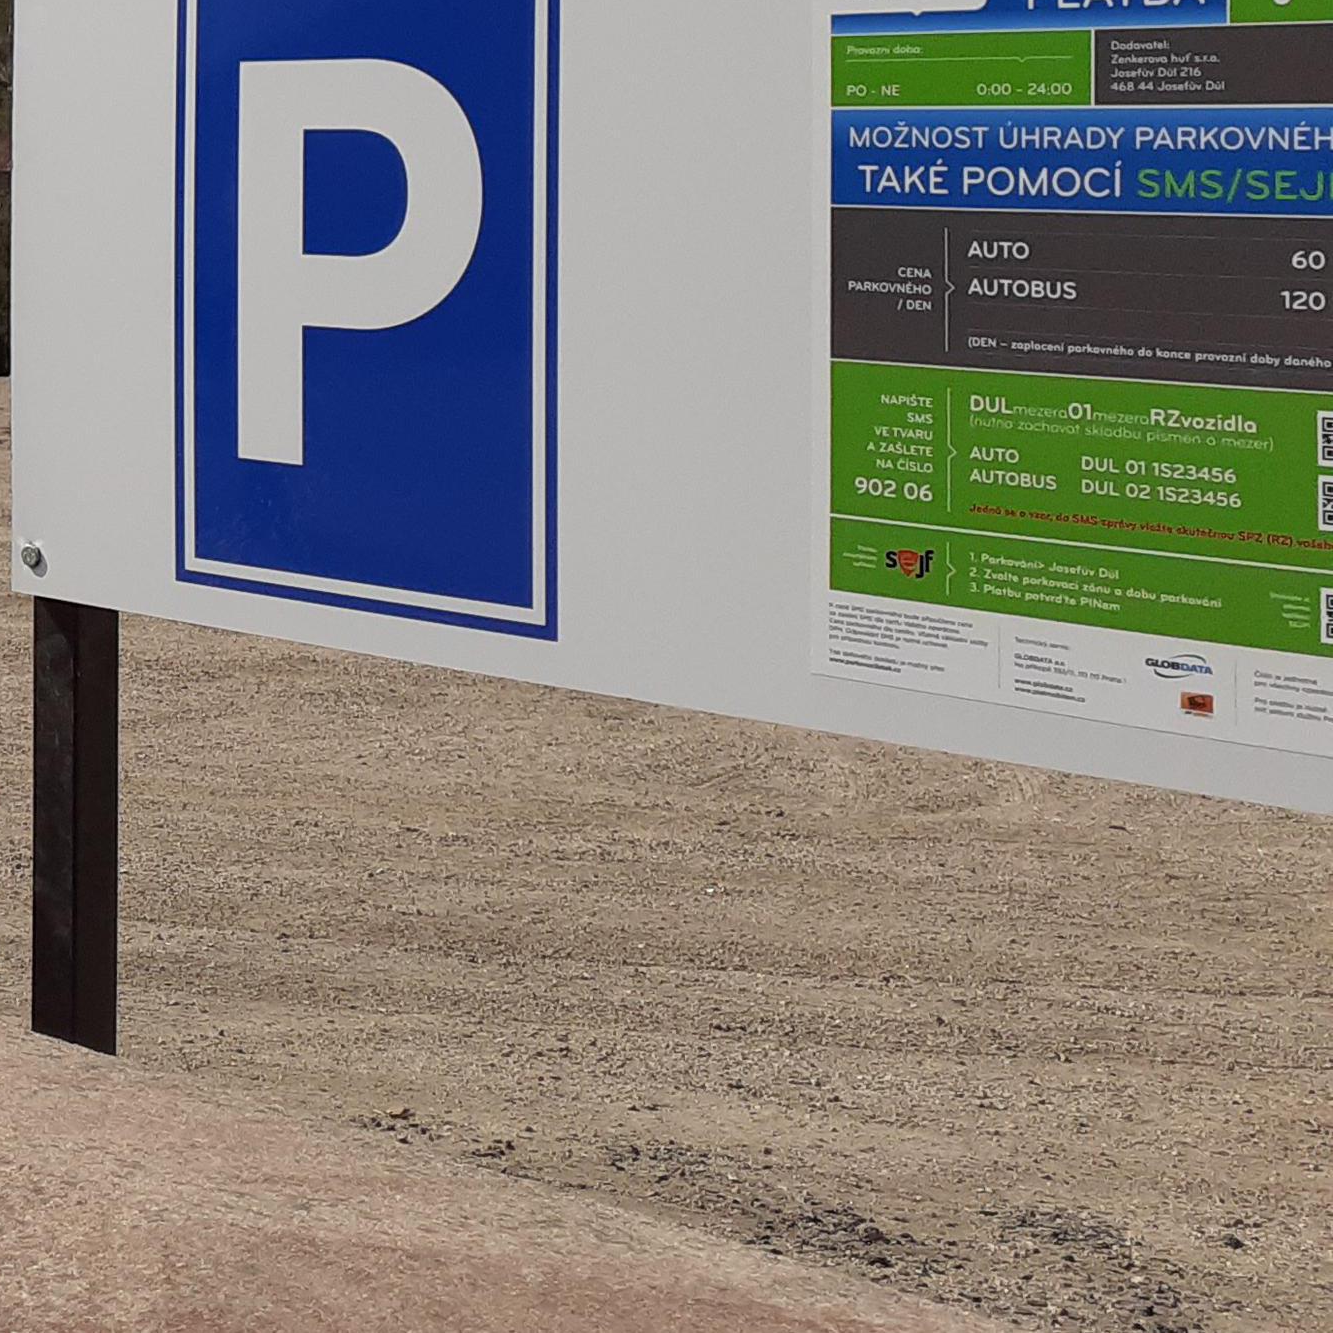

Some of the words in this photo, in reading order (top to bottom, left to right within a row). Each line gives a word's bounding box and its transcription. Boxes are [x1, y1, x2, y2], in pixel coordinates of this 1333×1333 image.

[1111, 41, 1170, 50] Dodavatel:
[1111, 54, 1168, 64] Zenkerova
[1111, 68, 1154, 78] Josefův
[1158, 67, 1177, 77] Důl
[1180, 67, 1201, 77] 216
[846, 84, 867, 96] PO
[881, 84, 900, 96] NE
[977, 83, 1012, 95] 0:00
[1027, 83, 1072, 95] 24:00
[1110, 82, 1134, 91] 468
[1138, 82, 1154, 91] 44
[1158, 81, 1202, 91] Josefův
[1205, 80, 1225, 90] Důl
[849, 121, 989, 149] MOŽNOST
[999, 121, 1125, 150] ÚHRADY
[858, 158, 949, 194] TAKÉ
[963, 159, 1123, 197] POMOCÍ
[968, 241, 1030, 259] AUTO
[236, 57, 484, 466] P
[1291, 251, 1326, 270] 60
[898, 267, 932, 278] CENA
[848, 280, 932, 295] PARKOVNÉHO
[968, 279, 1077, 299] AUTOBUS
[906, 300, 932, 310] DEN
[1281, 291, 1326, 310] 120
[968, 337, 996, 348] (DEN
[1011, 341, 1064, 352] zaplacení
[1067, 343, 1134, 357] parkovného
[1138, 347, 1152, 357] do
[1156, 348, 1191, 360] konce
[1195, 350, 1246, 363] provozní
[1250, 354, 1280, 366] doby
[880, 393, 933, 408] NAPIŠTE
[907, 413, 933, 423] SMS
[874, 427, 891, 437] VE
[893, 428, 932, 440] TVARU
[867, 442, 875, 451] A
[879, 440, 933, 457] ZAŠLETE
[876, 458, 894, 469] NA
[897, 457, 932, 473] ČÍSLO
[970, 446, 1019, 464] AUTO
[1081, 456, 1120, 472] DUL
[1125, 460, 1146, 476] 01
[1152, 462, 1236, 484] 1S23456
[854, 477, 897, 497] 902
[903, 482, 933, 501] 06
[970, 468, 1057, 490] AUTOBUS
[1081, 479, 1120, 496] DUL
[1125, 483, 1151, 499] 02
[1156, 485, 1242, 508] 1S23456
[969, 552, 978, 563] 1.
[1098, 567, 1120, 579] Důl
[969, 567, 979, 577] 2.
[984, 569, 1019, 583] Zvolte
[1126, 587, 1157, 600] dobu
[969, 582, 980, 593] 3.
[983, 584, 1021, 598] Platbu
[1145, 657, 1213, 676] GLOBDATA
